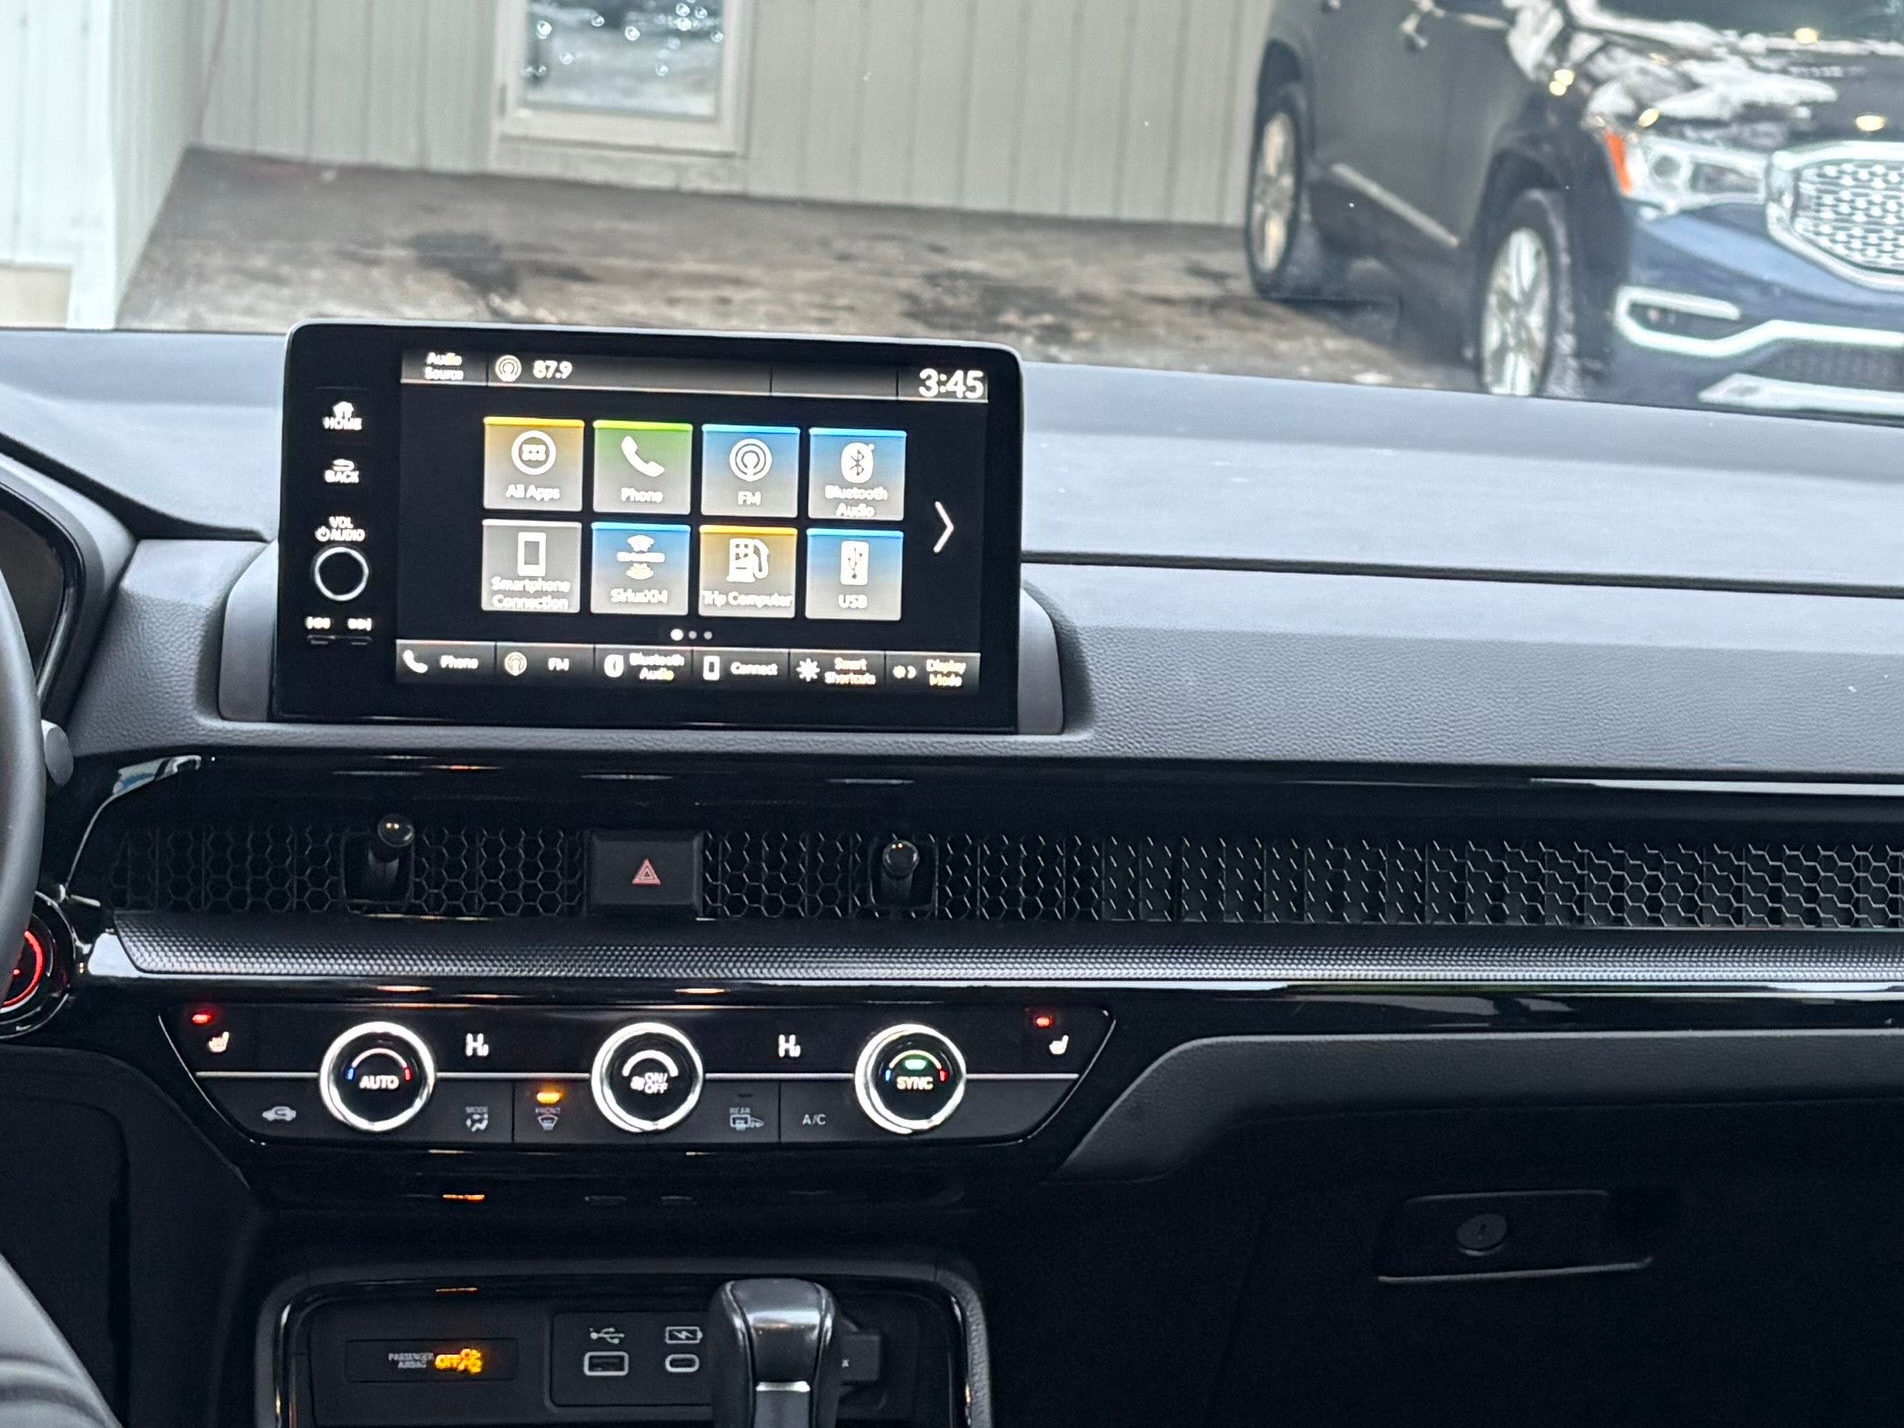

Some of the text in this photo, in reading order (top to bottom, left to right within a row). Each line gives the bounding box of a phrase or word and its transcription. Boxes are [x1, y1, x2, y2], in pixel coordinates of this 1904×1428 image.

[532, 360, 573, 379] 87.9
[918, 368, 984, 399] 3:45
[322, 417, 362, 430] HOME
[324, 471, 359, 483] BACK
[505, 484, 560, 502] All Apps
[620, 487, 663, 503] Phone
[737, 491, 762, 506] FM
[824, 484, 888, 501] Bluetooth
[836, 502, 876, 518] Audio
[329, 516, 353, 529] VOL
[330, 529, 365, 542] AUDIO
[491, 576, 571, 593] Smartphone
[492, 594, 569, 611] Connection
[702, 590, 793, 608] Trip Computer
[838, 594, 868, 609] USB
[440, 655, 479, 669] Phone
[548, 657, 570, 671] FM
[359, 1075, 400, 1090] AUTO
[644, 1072, 668, 1084] ON/
[896, 1075, 934, 1091] SYNC
[644, 1082, 669, 1095] OFF
[802, 1113, 827, 1126] A/C
